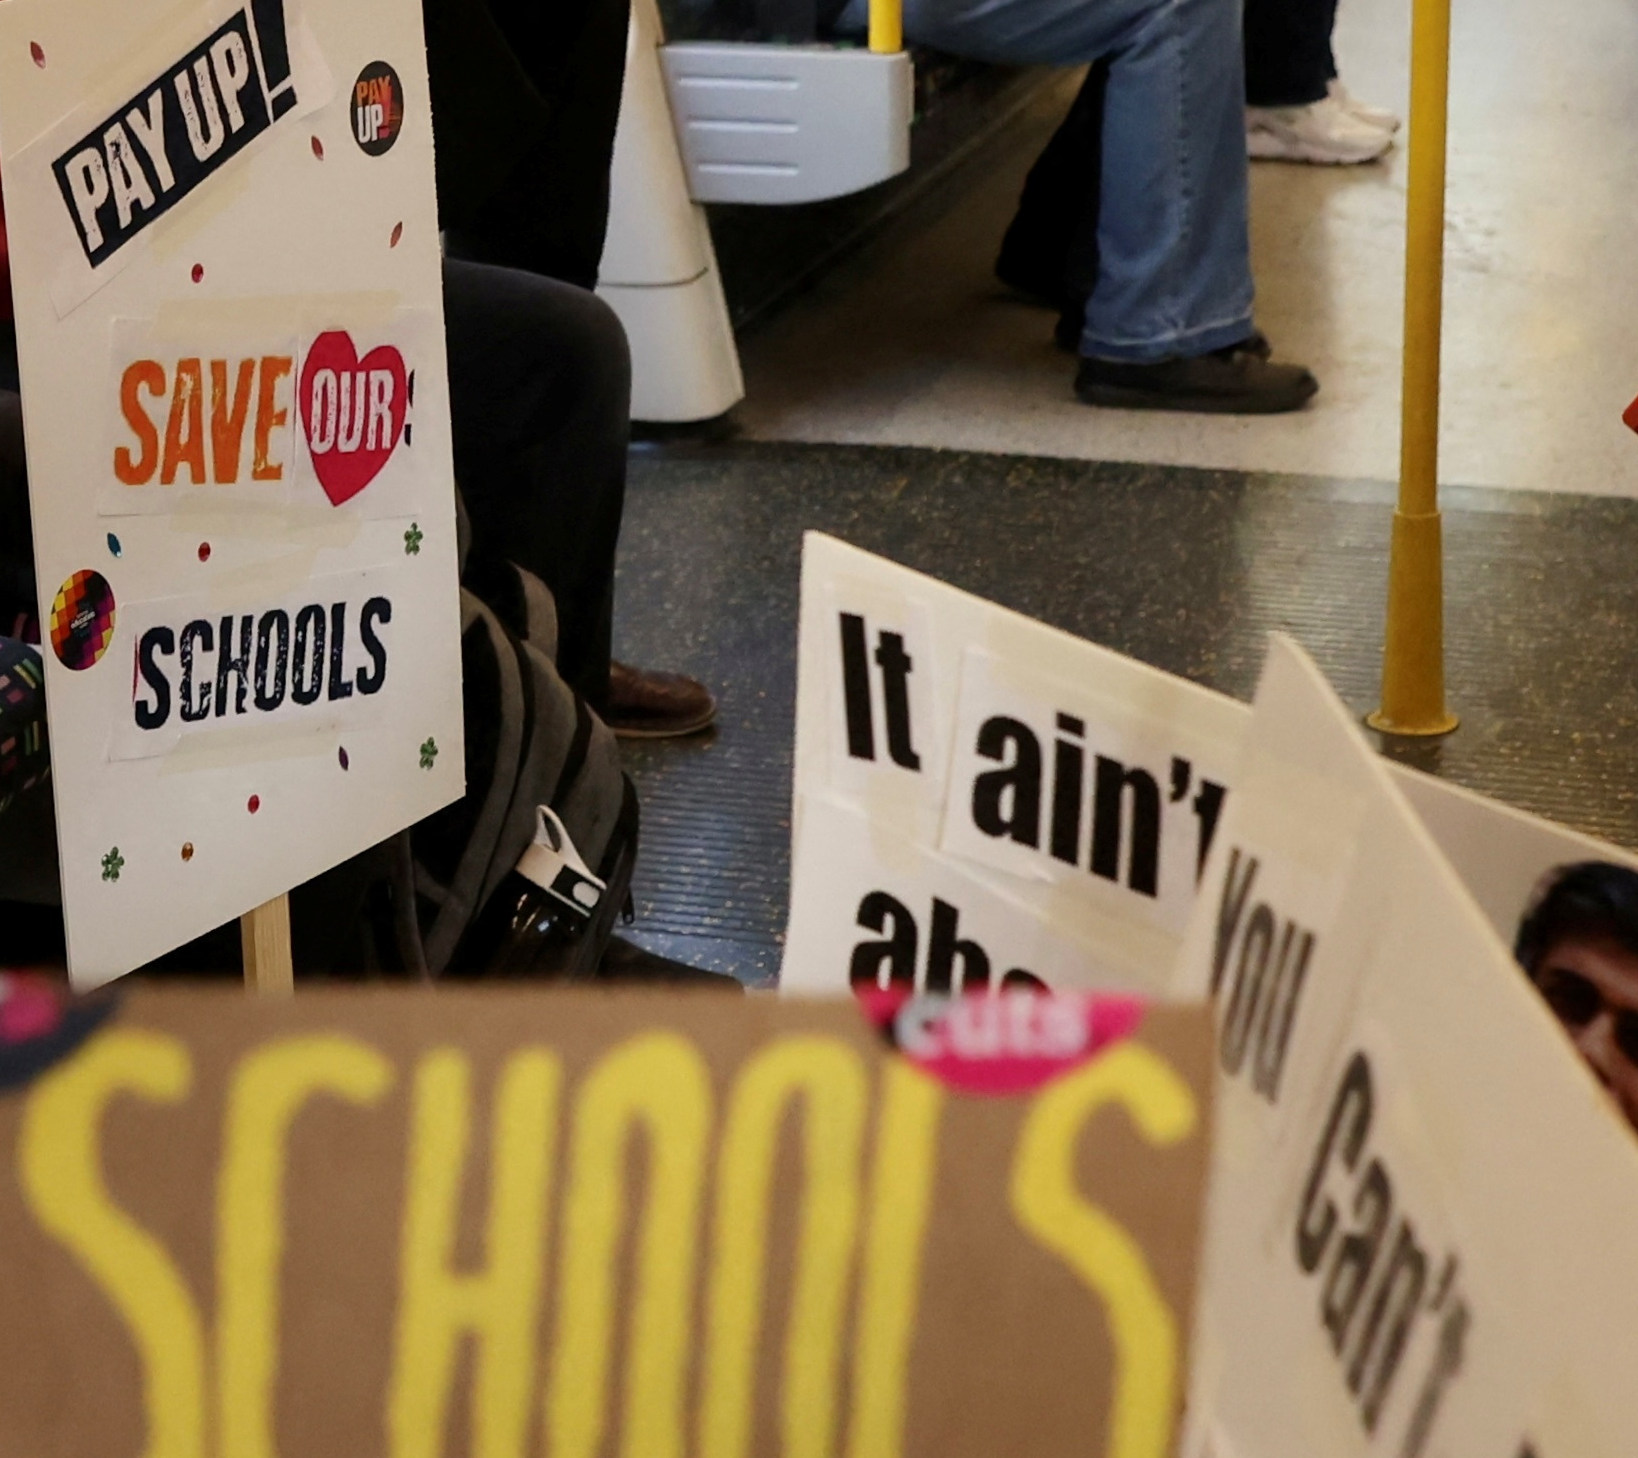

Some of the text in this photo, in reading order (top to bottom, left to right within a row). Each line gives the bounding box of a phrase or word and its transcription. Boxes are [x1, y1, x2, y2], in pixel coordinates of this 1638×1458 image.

[357, 75, 390, 106] PAY
[64, 88, 177, 254] PAY
[114, 355, 396, 486] SAVE OUR
[134, 596, 392, 731] SCHOOLS
[836, 612, 922, 773] It
[1213, 844, 1318, 1105] You
